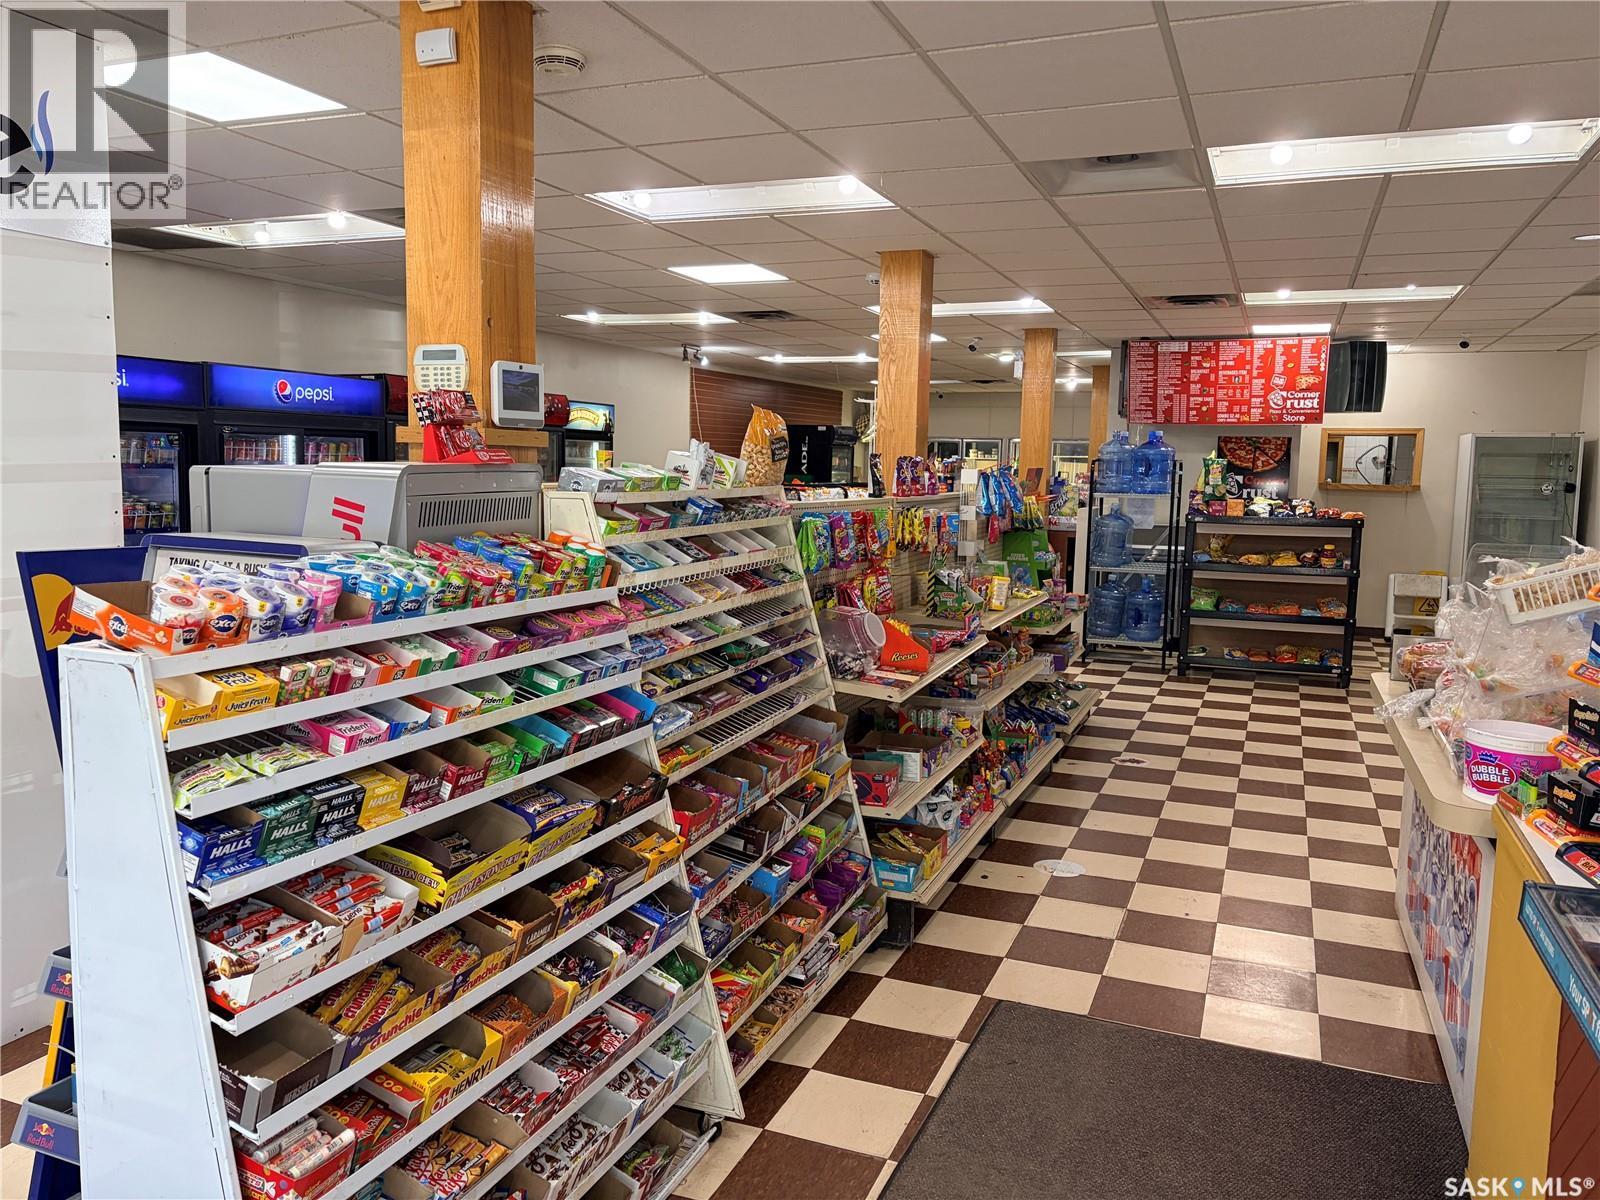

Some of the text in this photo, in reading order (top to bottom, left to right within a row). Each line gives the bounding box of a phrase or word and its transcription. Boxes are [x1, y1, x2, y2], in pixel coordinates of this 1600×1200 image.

[296, 386, 334, 403] pepsi
[1282, 414, 1306, 422] Store
[108, 619, 128, 634] excel
[338, 722, 370, 736] Trident
[358, 734, 382, 747] Trident
[458, 770, 484, 786] HALLS
[1471, 765, 1509, 776] DUBBLE
[411, 777, 440, 792] HALLS
[1472, 774, 1511, 784] BUBBLE
[276, 800, 298, 810] HALLS
[331, 792, 353, 806] HALLS
[368, 792, 398, 809] HALLS
[280, 808, 300, 822] HALLS
[321, 804, 356, 824] HALLS
[270, 820, 308, 840] HALLS
[210, 836, 252, 860] HALLS
[223, 862, 251, 874] HALLS
[370, 859, 417, 879] HARLESTON
[416, 872, 440, 890] CHEW
[226, 929, 254, 947] bueno
[462, 960, 500, 994] crunchie
[344, 977, 378, 1019] crunchie
[1569, 974, 1582, 1007] Your
[369, 1007, 424, 1050] crunchie
[451, 1057, 494, 1096] HENRY!
